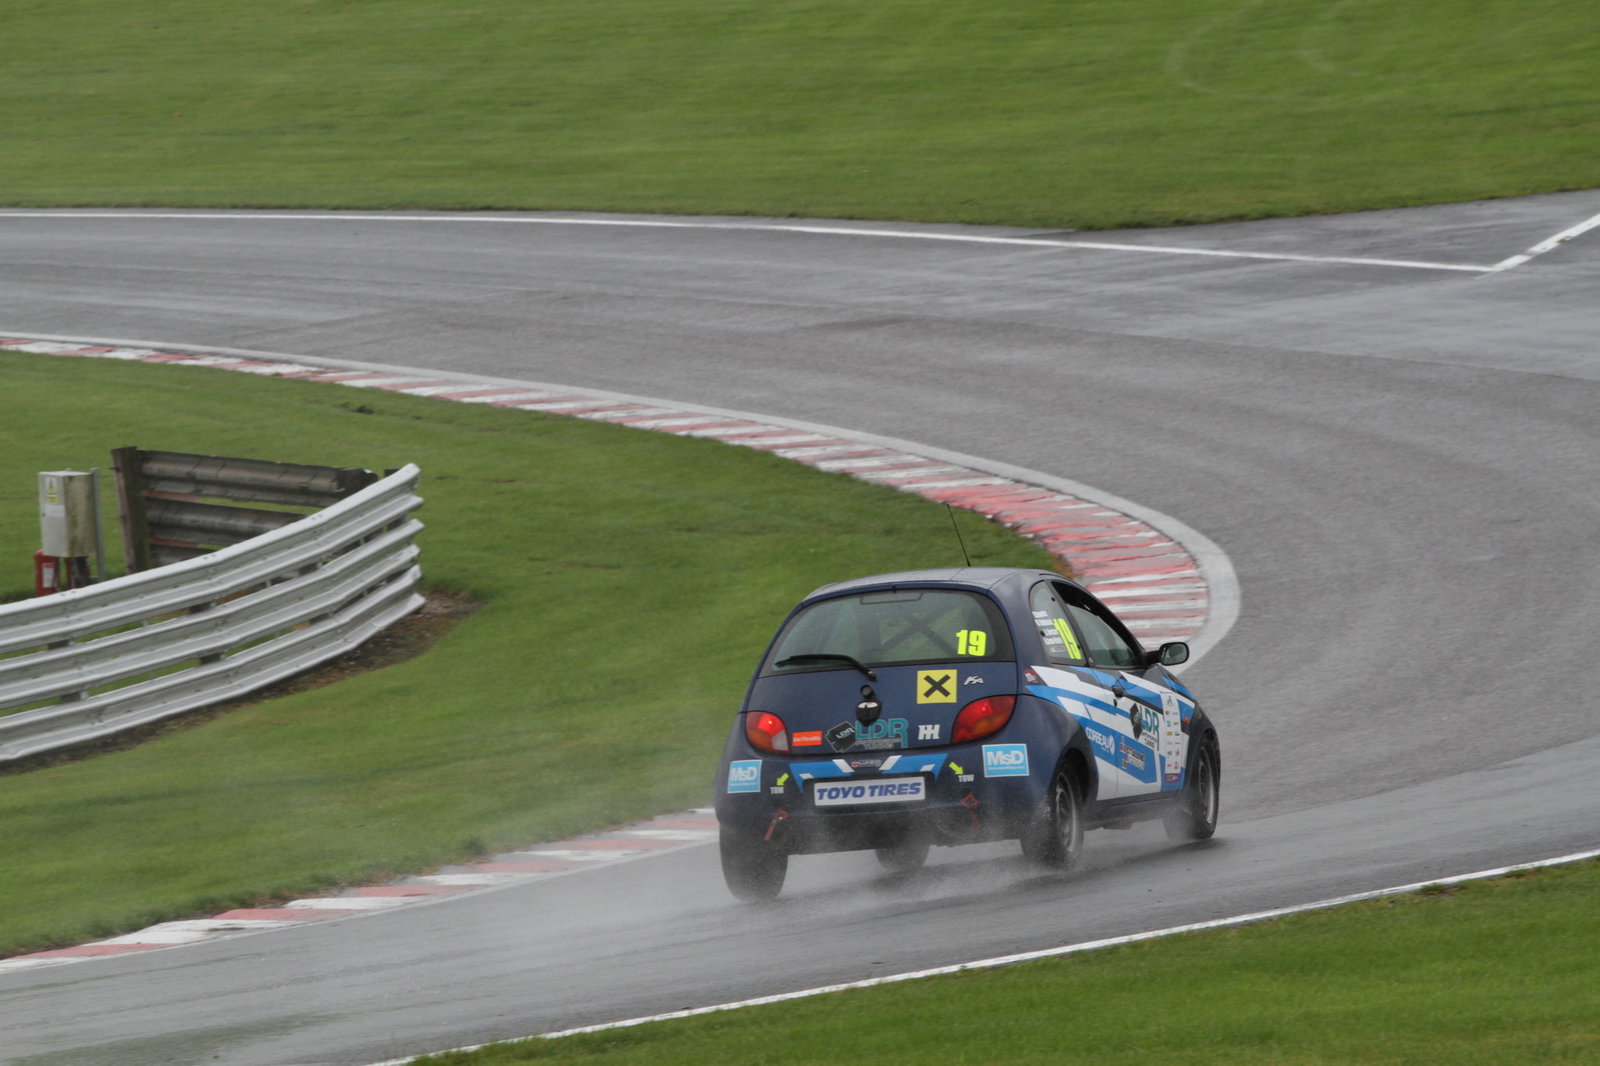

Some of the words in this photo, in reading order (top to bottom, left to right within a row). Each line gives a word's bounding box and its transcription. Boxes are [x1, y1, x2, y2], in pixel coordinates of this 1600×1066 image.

[956, 629, 987, 656] 19
[836, 727, 855, 739] LDR
[855, 717, 908, 748] LDR
[987, 750, 1024, 765] MsD
[730, 766, 757, 782] MsD
[816, 786, 864, 801] TOYO
[867, 782, 921, 799] TIRES
